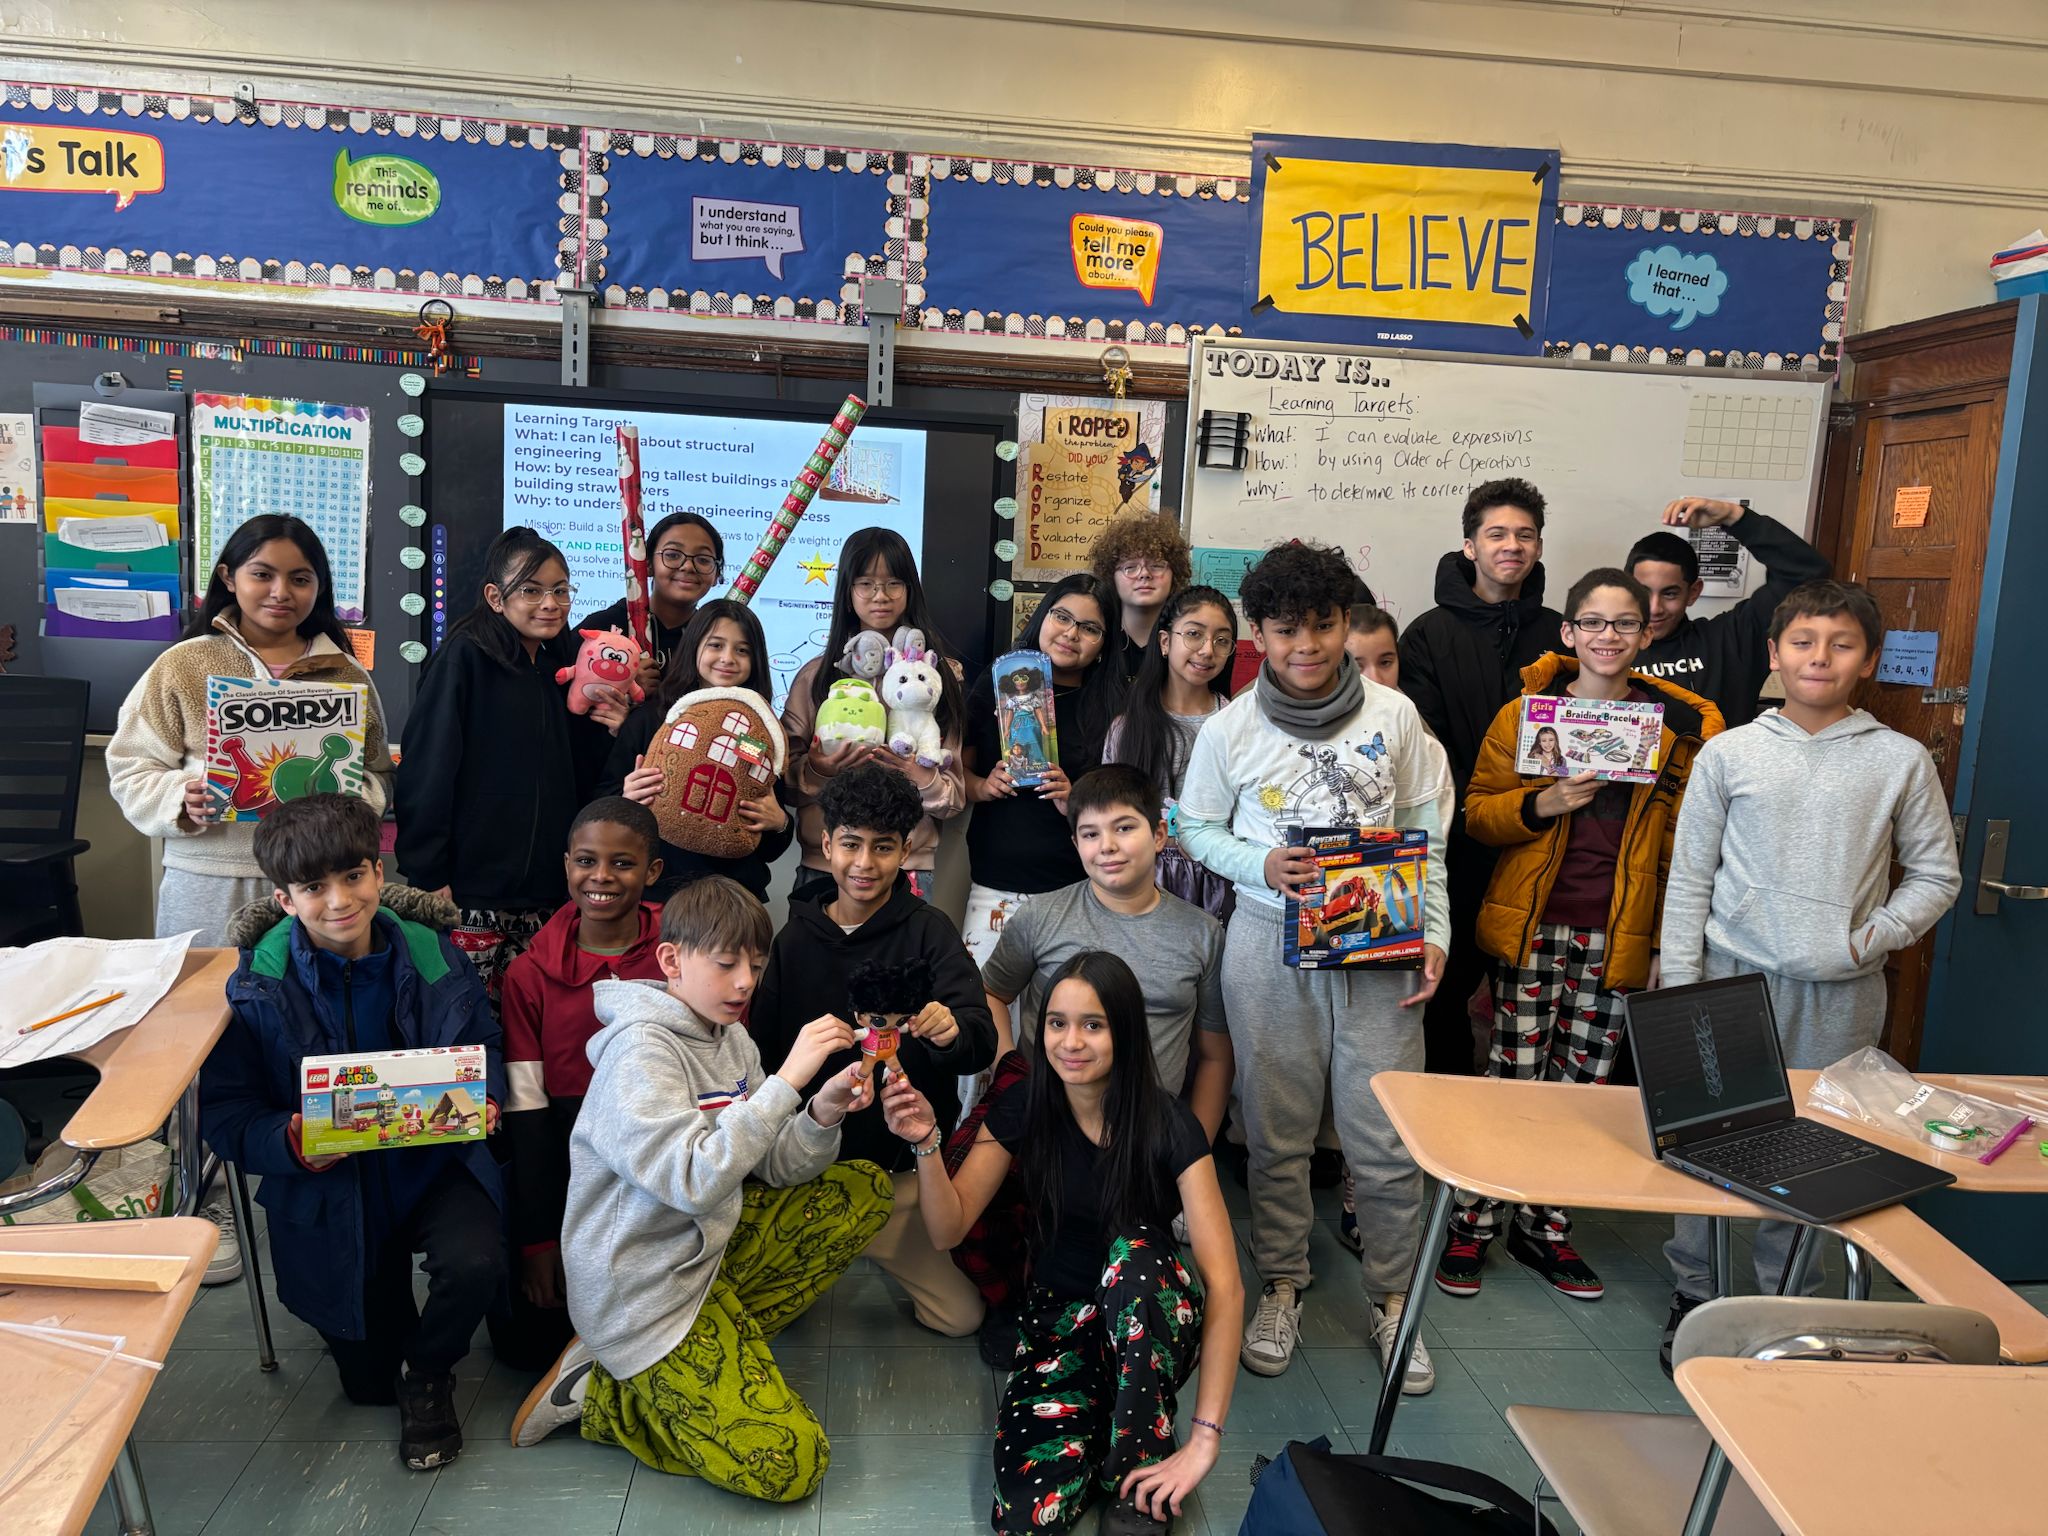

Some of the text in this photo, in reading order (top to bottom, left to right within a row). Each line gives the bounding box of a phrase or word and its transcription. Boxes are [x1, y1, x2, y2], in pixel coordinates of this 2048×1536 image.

[58, 141, 139, 177] Talk
[376, 167, 398, 178] This
[346, 180, 429, 199] reminds
[367, 202, 384, 210] me
[700, 205, 786, 223] I understand
[700, 220, 723, 230] what
[725, 223, 743, 232] you
[762, 226, 796, 238] saying,
[1079, 222, 1154, 238] Could you please
[700, 232, 723, 245] but
[727, 234, 731, 246] I
[1083, 235, 1146, 257] tell me
[1291, 211, 1530, 296] BELIEVE
[1086, 254, 1134, 271] more
[1648, 263, 1710, 287] I learned
[1391, 333, 1413, 341] LASSO
[1206, 350, 1326, 382] TODAY
[1269, 385, 1421, 425] Learning Targets:
[214, 415, 352, 441] MULTIPLICATION
[515, 412, 578, 428] Learning
[1069, 415, 1131, 438] ROPED
[515, 428, 558, 442] What:
[562, 431, 566, 442] I
[570, 433, 596, 444] can
[640, 436, 682, 449] about
[685, 440, 755, 454] structural
[1064, 438, 1080, 446] the
[1255, 424, 1533, 449] What: I can evaluate expressions
[251, 441, 256, 449] 3
[274, 443, 279, 451] 5
[320, 447, 326, 455] 9
[330, 448, 339, 456] 10
[342, 449, 350, 457] 11
[514, 445, 601, 462] engineering
[1068, 452, 1109, 468] DID you?
[1318, 449, 1336, 471] by
[1342, 453, 1383, 475] using
[1394, 450, 1431, 468] Order
[1436, 448, 1453, 470] of
[1459, 451, 1532, 477] Operations
[514, 461, 551, 474] How:
[555, 463, 572, 476] by
[664, 470, 708, 483] tallest
[711, 473, 777, 489] buildings
[514, 477, 573, 493] building
[577, 482, 617, 493] straw
[1246, 480, 1285, 500] Why:
[1308, 483, 1327, 502] to
[1331, 482, 1394, 501] determine
[1403, 481, 1417, 499] its
[514, 494, 551, 508] Why:
[555, 497, 569, 507] to
[660, 502, 684, 512] the
[687, 505, 773, 521] engineering
[524, 519, 567, 530] Mission:
[569, 521, 594, 532] Build
[1066, 512, 1083, 525] of
[566, 541, 592, 550] AND
[744, 532, 755, 541] to
[798, 535, 830, 547] weight
[583, 553, 609, 564] solve
[1064, 552, 1072, 560] it
[235, 691, 257, 699] Classic
[307, 687, 333, 695] Revenge
[223, 697, 353, 731] SORRY!
[1531, 701, 1554, 713] girl's
[1565, 709, 1602, 722] Braiding
[1603, 711, 1641, 724] Bracelet
[1386, 947, 1422, 957] CHALLENGE
[339, 1064, 373, 1076] SUPER
[308, 1073, 329, 1084] LEGO
[333, 1072, 379, 1087] MARIO
